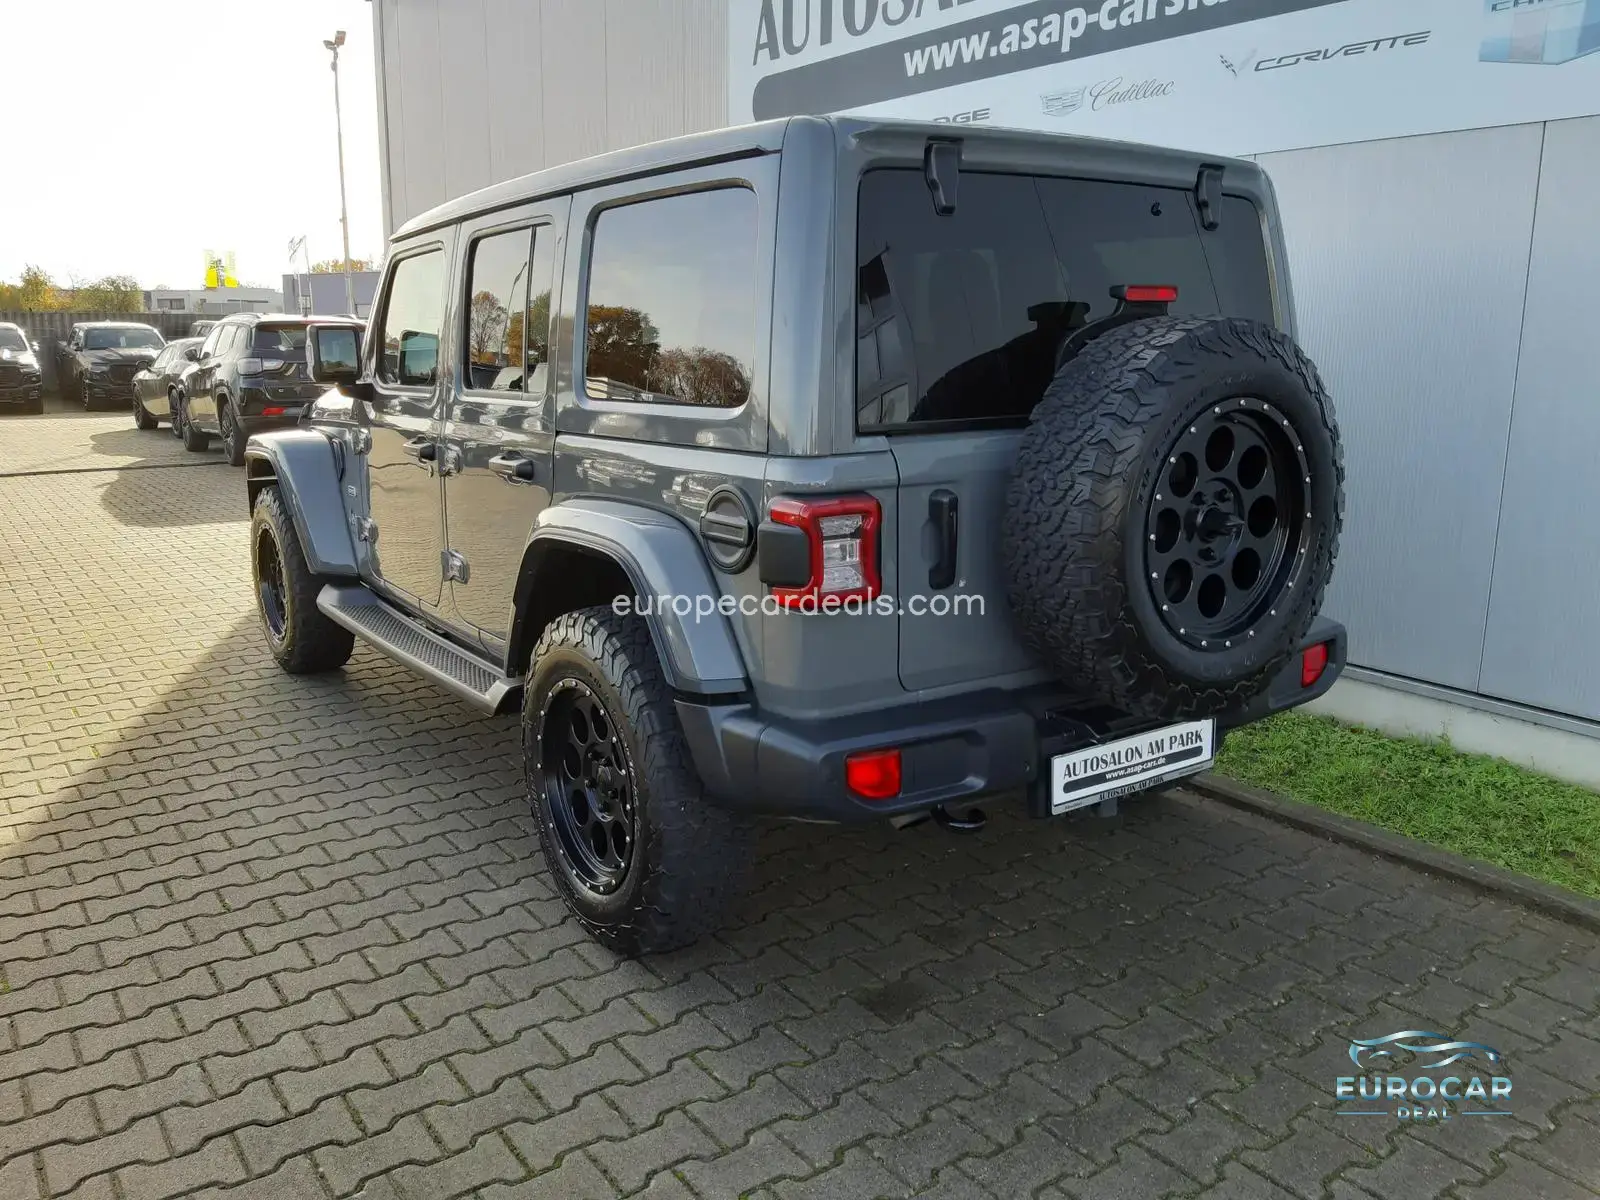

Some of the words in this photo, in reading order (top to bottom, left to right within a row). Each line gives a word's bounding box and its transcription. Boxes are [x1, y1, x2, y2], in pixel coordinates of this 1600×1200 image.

[1254, 30, 1431, 72] CORVETTE
[1089, 76, 1175, 112] Cadillac
[1063, 745, 1143, 780] AUTOSALON
[1147, 738, 1165, 756] AM
[1169, 729, 1203, 750] PARK
[1105, 757, 1166, 780] www.asap-cars.de
